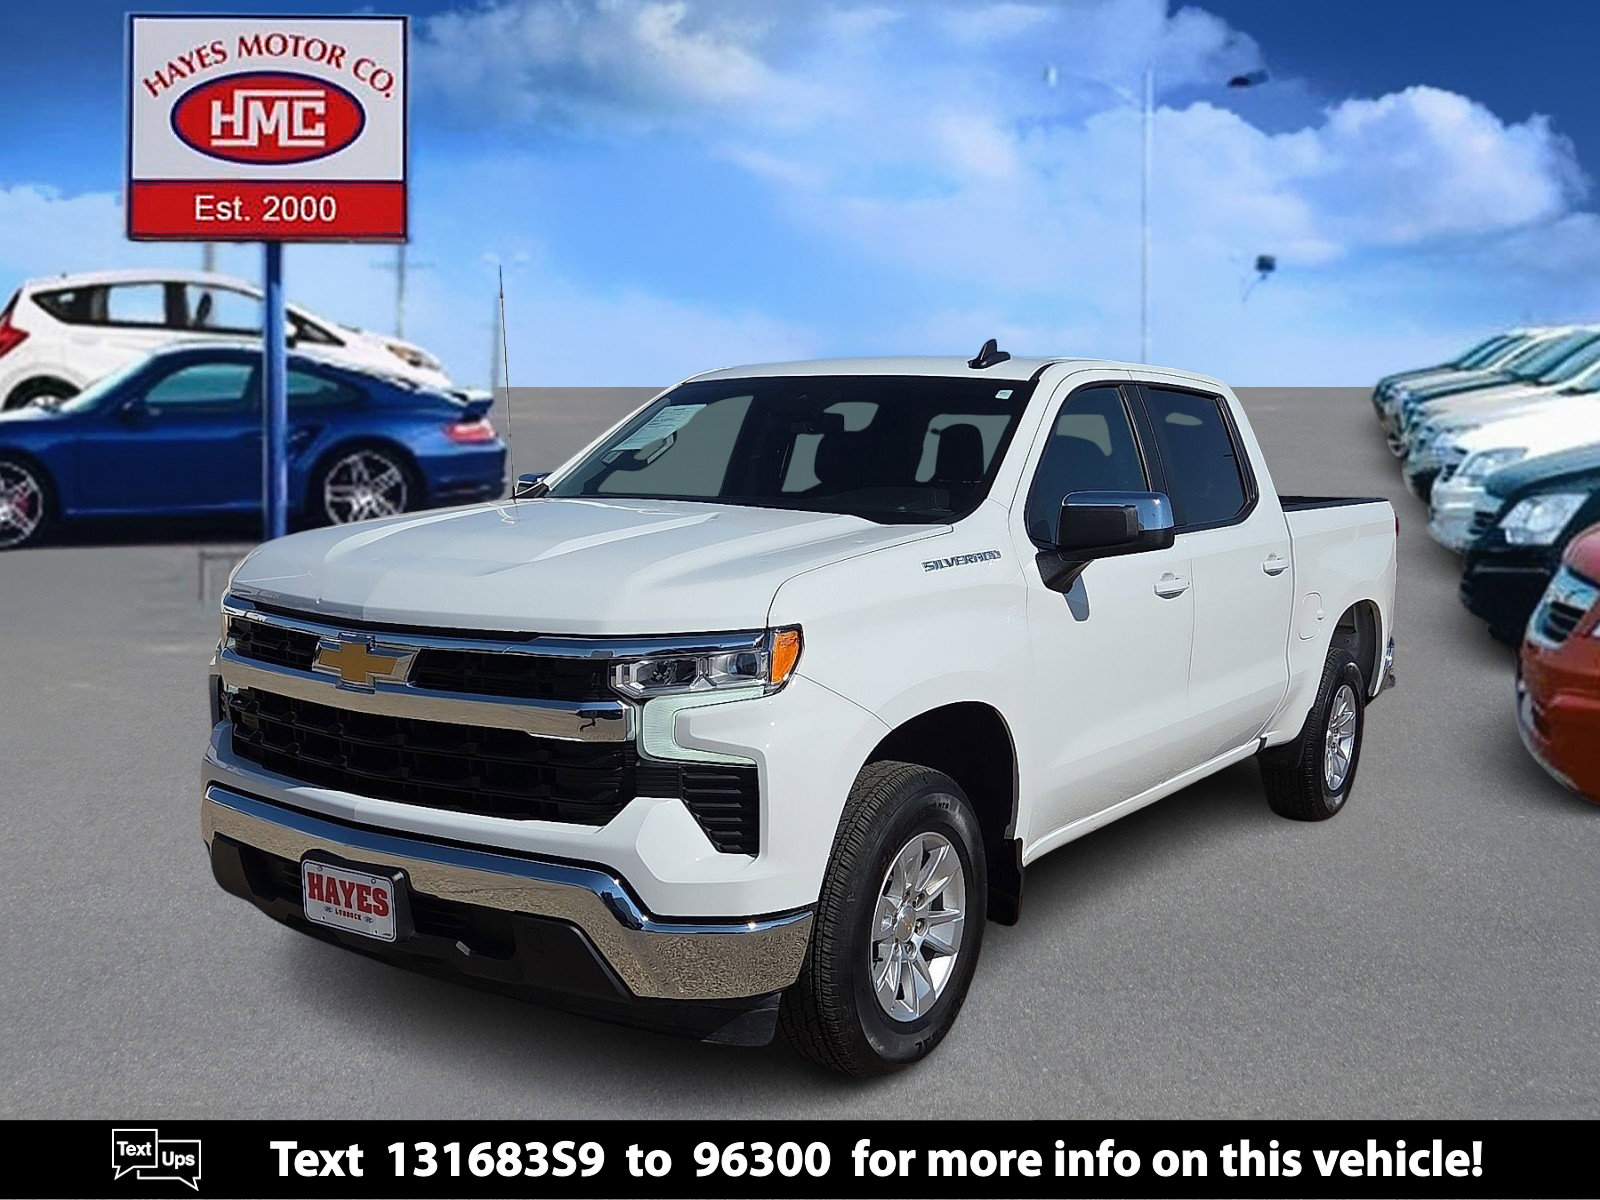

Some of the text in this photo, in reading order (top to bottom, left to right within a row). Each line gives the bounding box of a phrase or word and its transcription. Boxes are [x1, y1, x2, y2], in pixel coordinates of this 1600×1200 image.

[143, 33, 395, 98] HAYES MOTOR CO.
[210, 88, 326, 147] HMC
[195, 194, 337, 222] Est. 2000
[921, 549, 1002, 572] SILVERADO
[307, 871, 390, 917] HAYES
